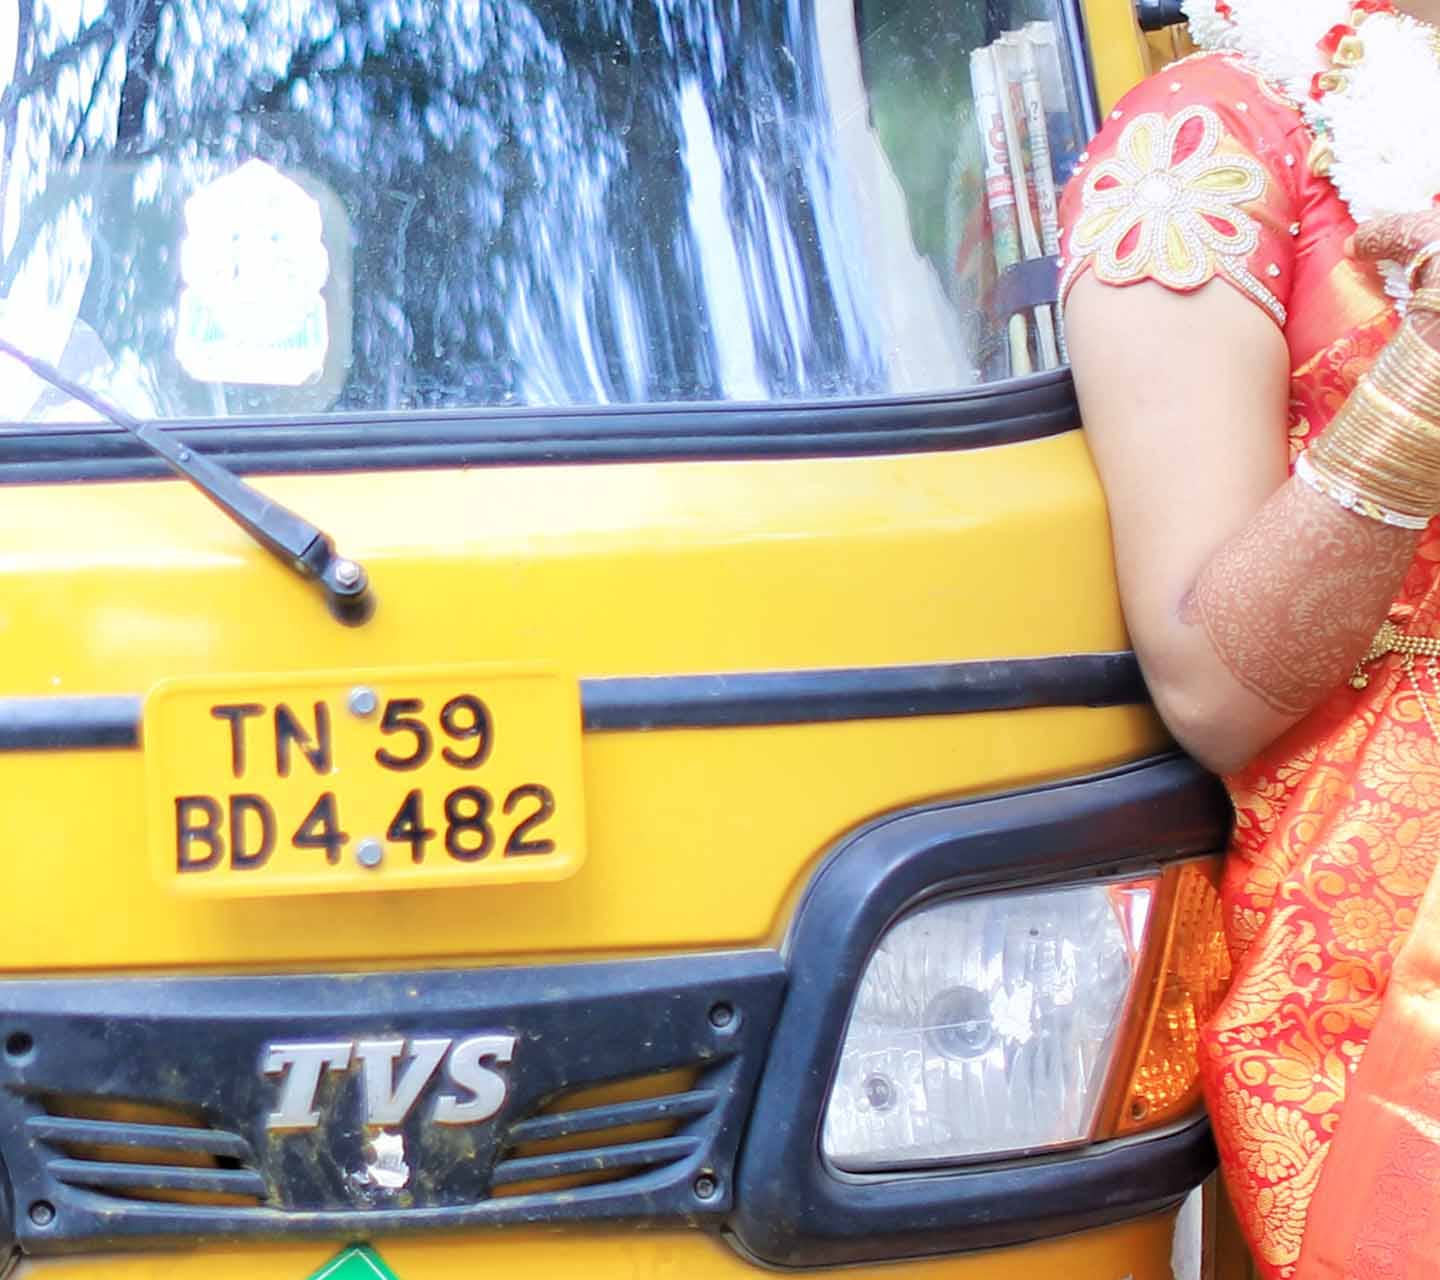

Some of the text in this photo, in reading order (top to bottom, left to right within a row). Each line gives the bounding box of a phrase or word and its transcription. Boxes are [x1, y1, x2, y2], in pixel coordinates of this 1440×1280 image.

[210, 693, 495, 779] TN 59
[264, 1034, 517, 1130] TVS
